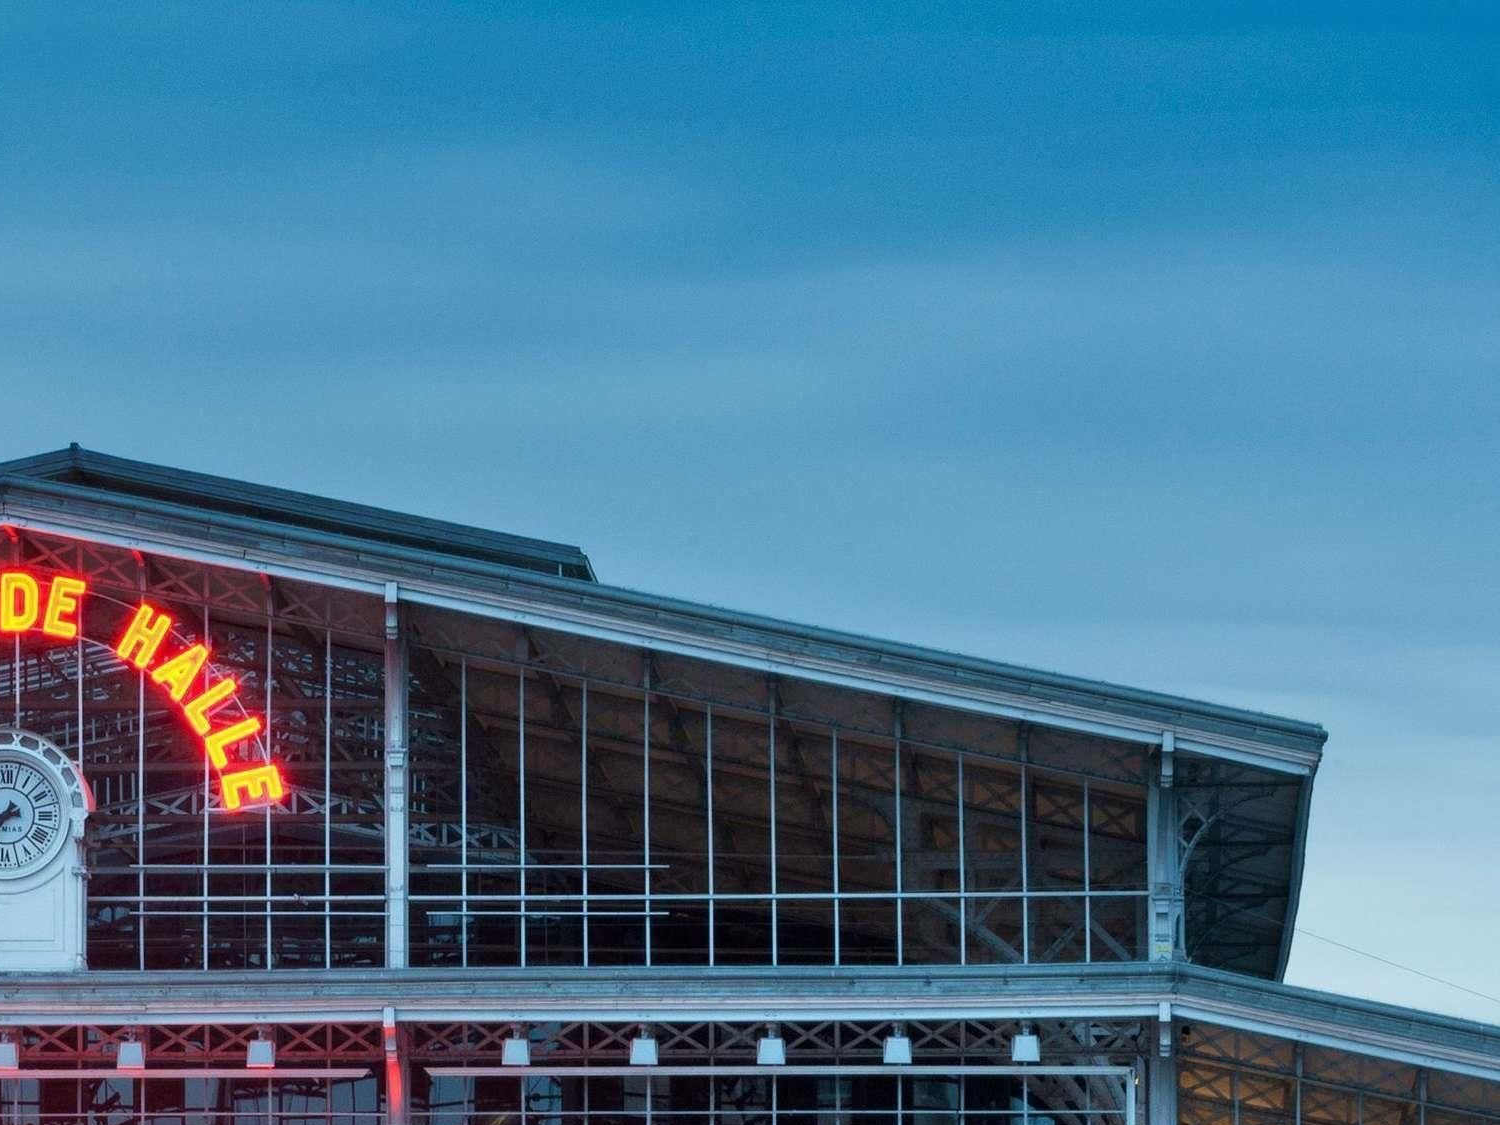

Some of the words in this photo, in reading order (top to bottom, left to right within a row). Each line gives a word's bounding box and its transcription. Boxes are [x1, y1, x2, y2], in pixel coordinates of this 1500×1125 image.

[114, 603, 286, 813] HALLE
[0, 769, 14, 784] XII
[33, 790, 48, 803] II
[38, 811, 53, 821] III
